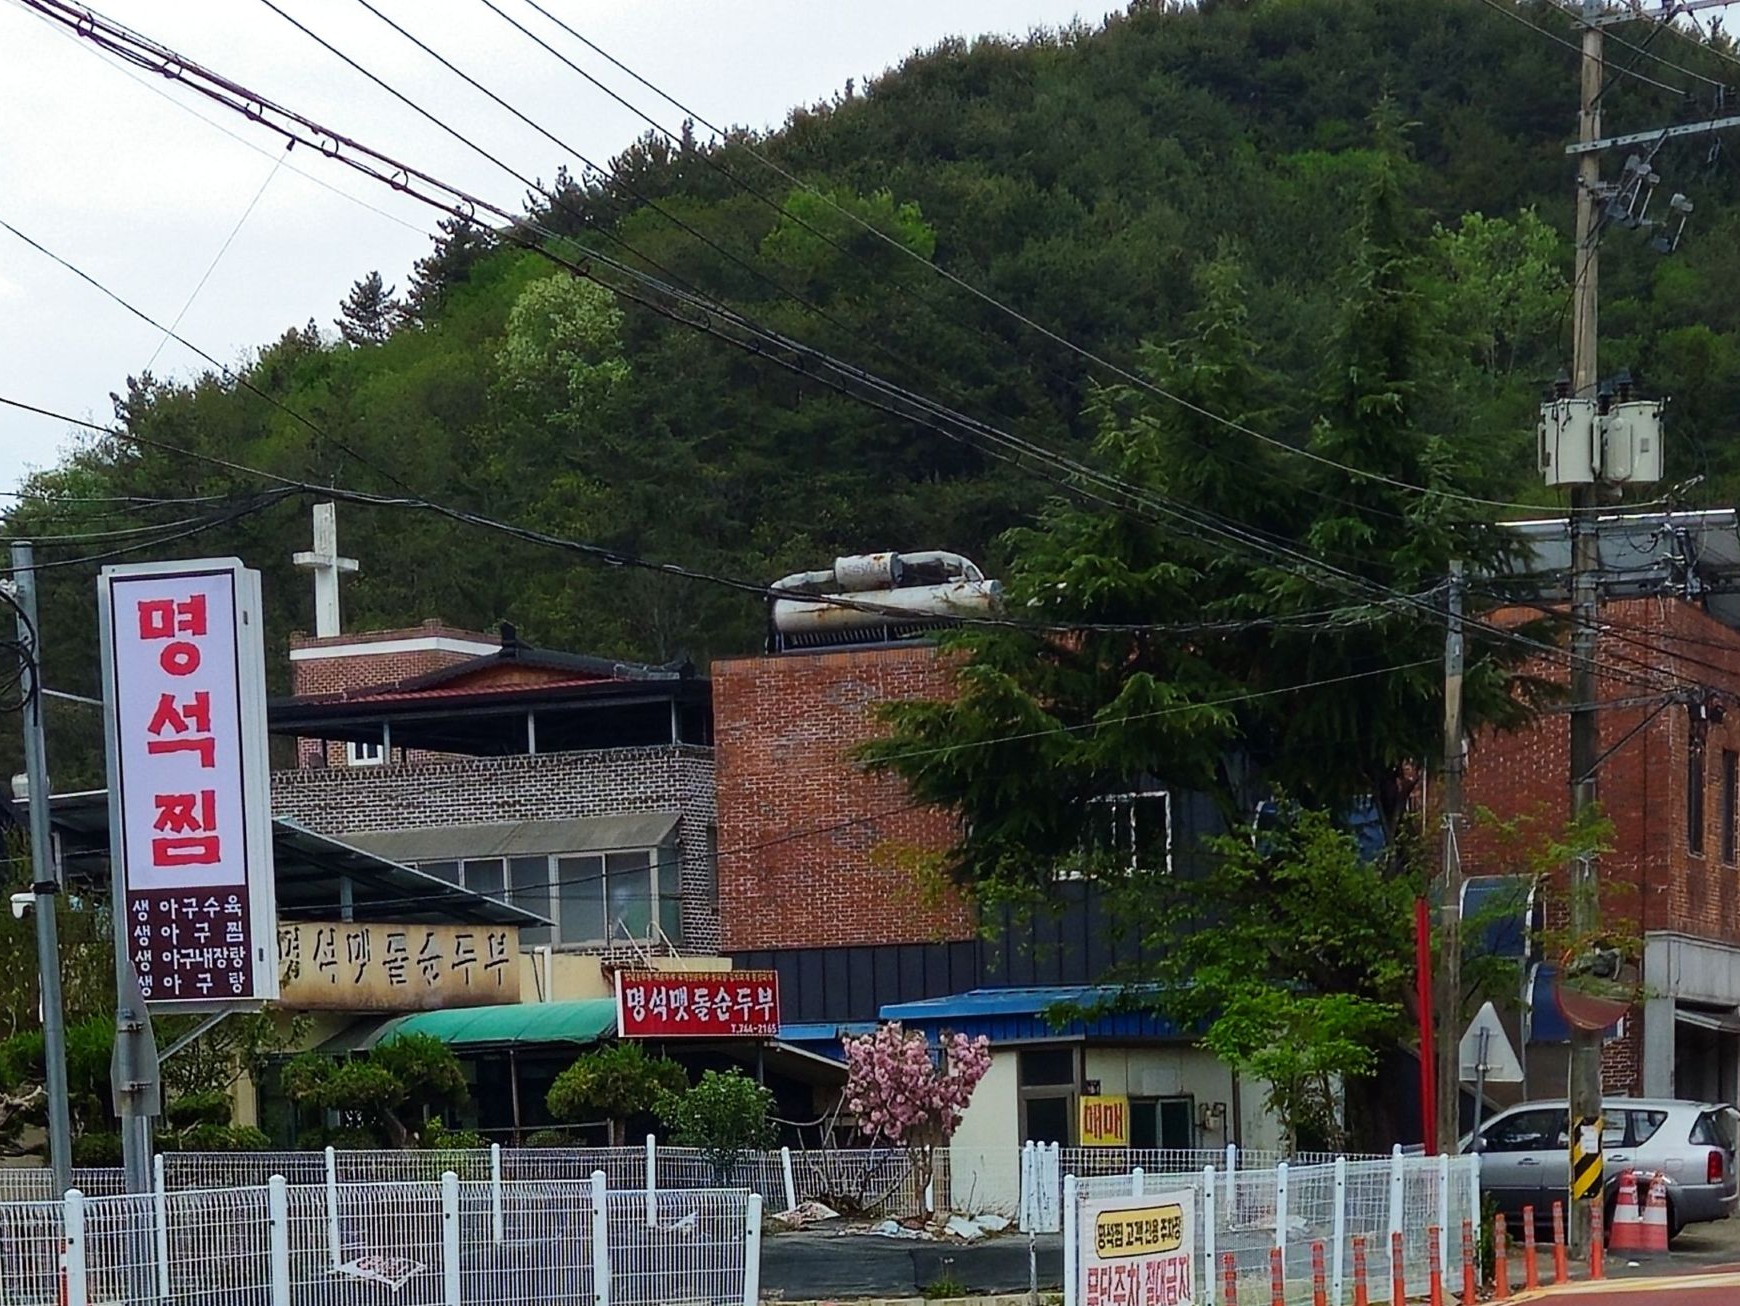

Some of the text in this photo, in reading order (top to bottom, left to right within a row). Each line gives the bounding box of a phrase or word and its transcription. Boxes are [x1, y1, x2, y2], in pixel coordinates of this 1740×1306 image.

[138, 594, 221, 867] 명석찜
[132, 895, 242, 921] 생 아구수육
[134, 924, 151, 946] 생
[135, 946, 246, 972] 생 아구내장탕
[139, 975, 153, 997] 생
[625, 985, 775, 1022] 명석맷돌순두부
[1084, 1102, 1124, 1140] 매매
